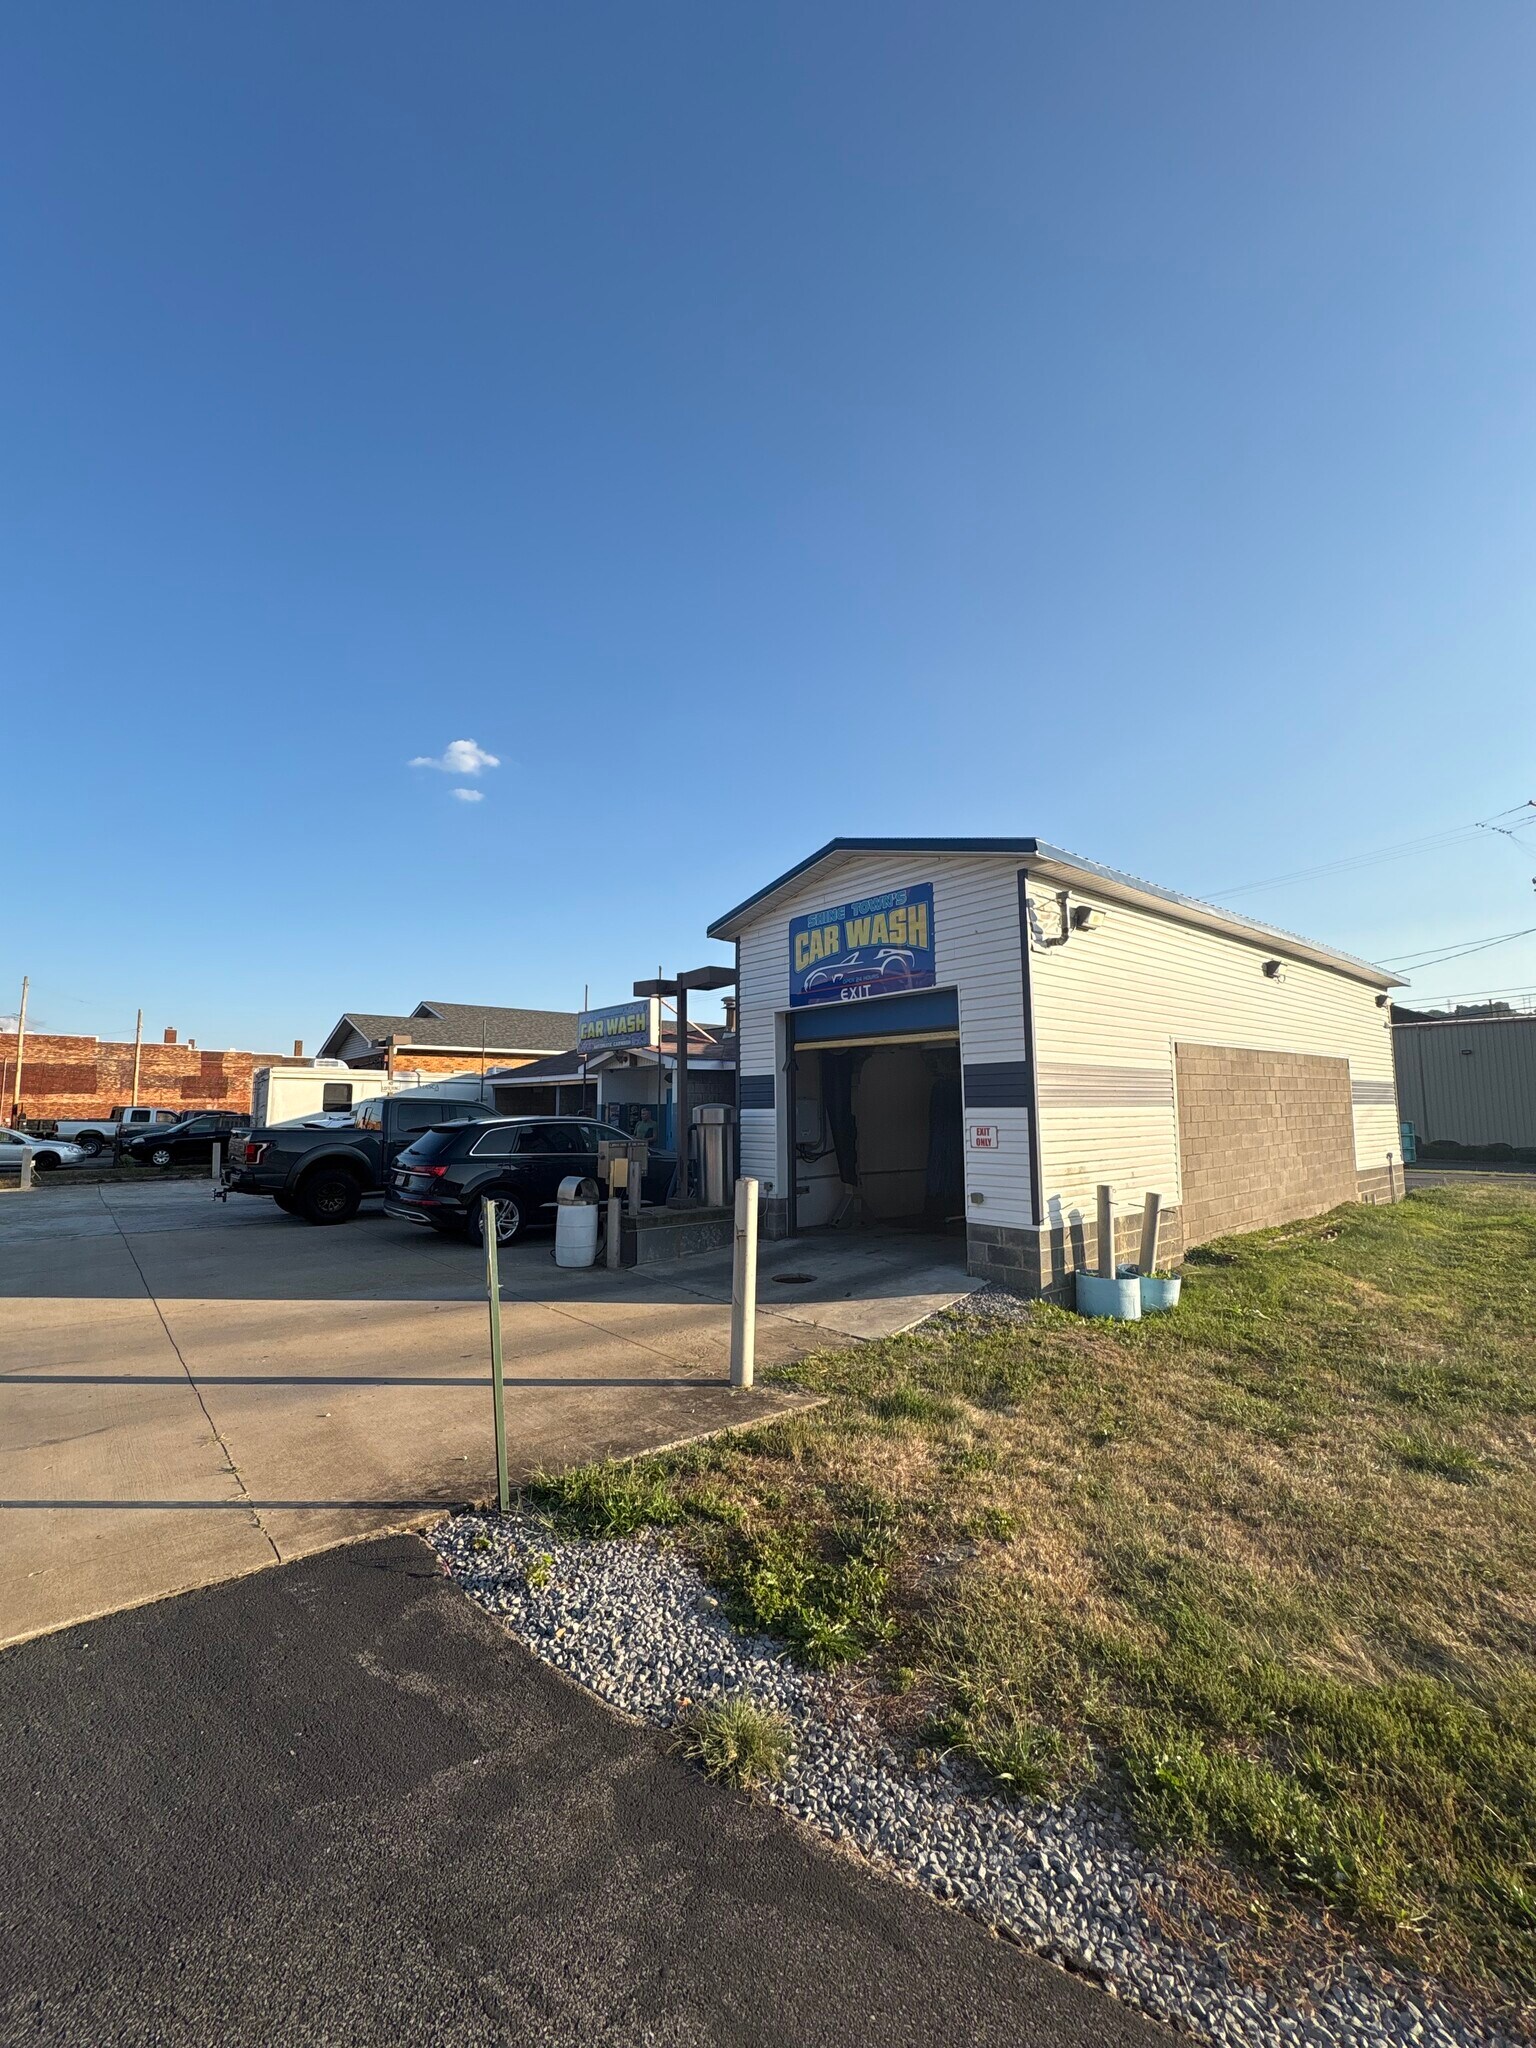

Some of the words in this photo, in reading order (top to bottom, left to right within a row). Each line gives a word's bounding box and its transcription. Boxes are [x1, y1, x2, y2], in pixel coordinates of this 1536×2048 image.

[808, 906, 845, 928] SHINE
[851, 890, 908, 916] TOWN'S
[795, 925, 840, 972] CAR
[845, 902, 928, 949] WASH
[841, 985, 871, 1000] EXIT
[580, 1020, 604, 1039] CAR
[606, 1013, 646, 1036] WASH
[976, 1128, 990, 1136] EXIT
[976, 1138, 992, 1146] ONLY
